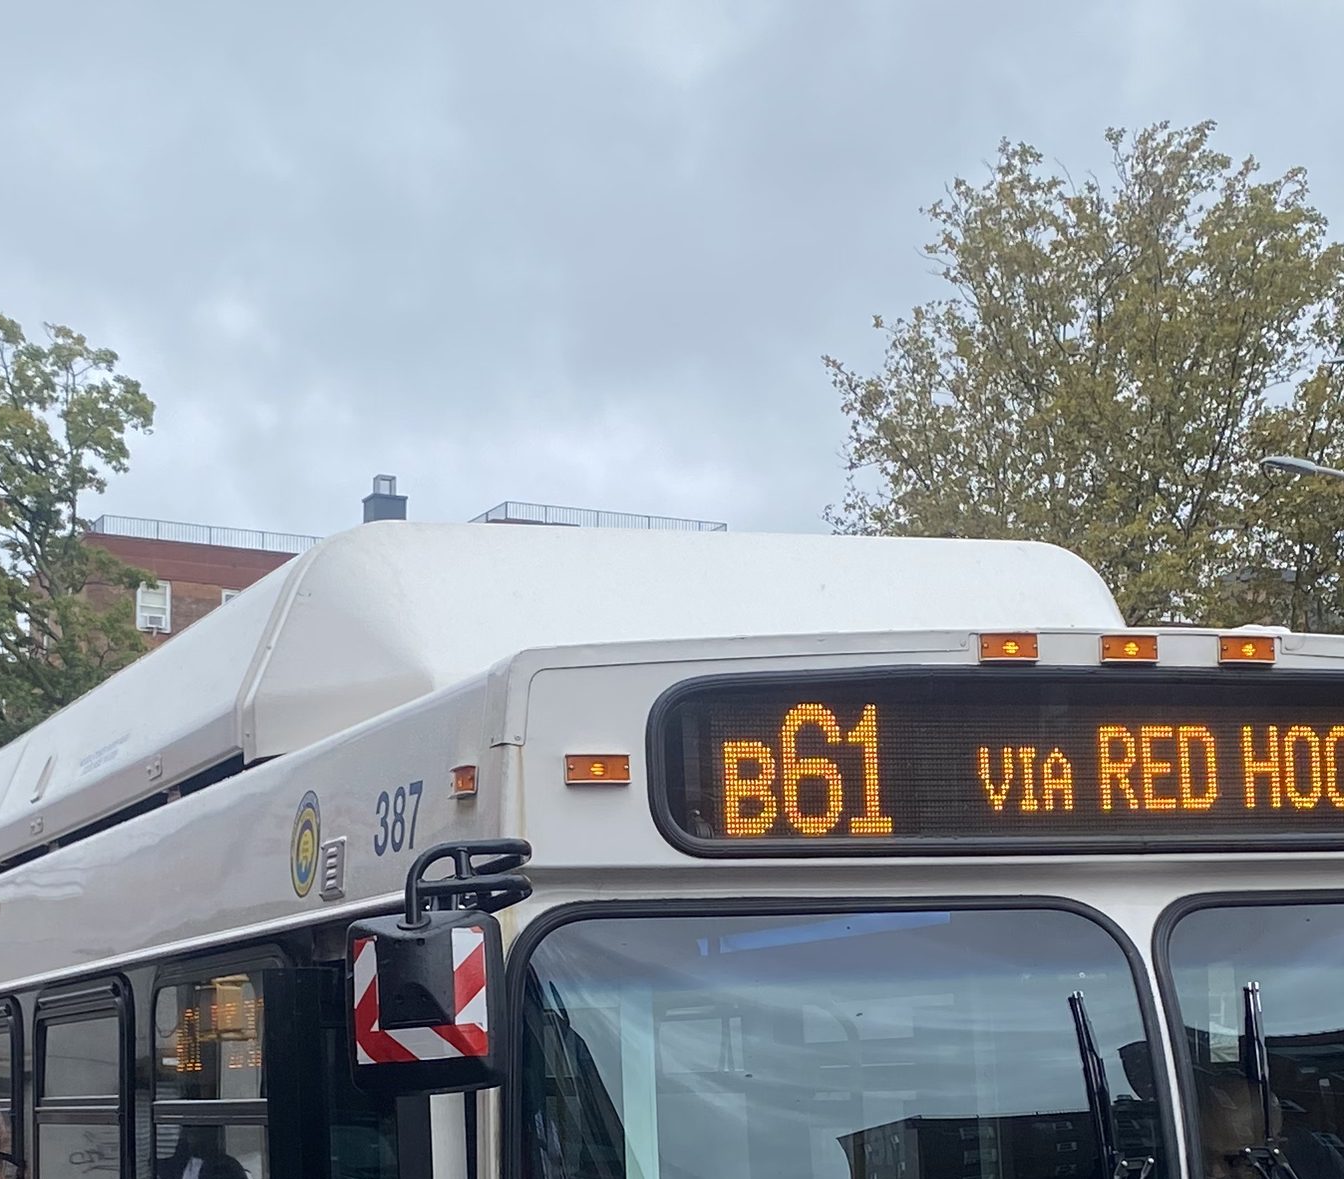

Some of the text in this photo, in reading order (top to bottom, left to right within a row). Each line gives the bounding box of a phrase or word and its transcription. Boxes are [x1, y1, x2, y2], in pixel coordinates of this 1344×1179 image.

[374, 780, 424, 857] 387
[721, 702, 893, 836] B61
[978, 746, 1074, 812] VIA
[1097, 724, 1218, 812] RED
